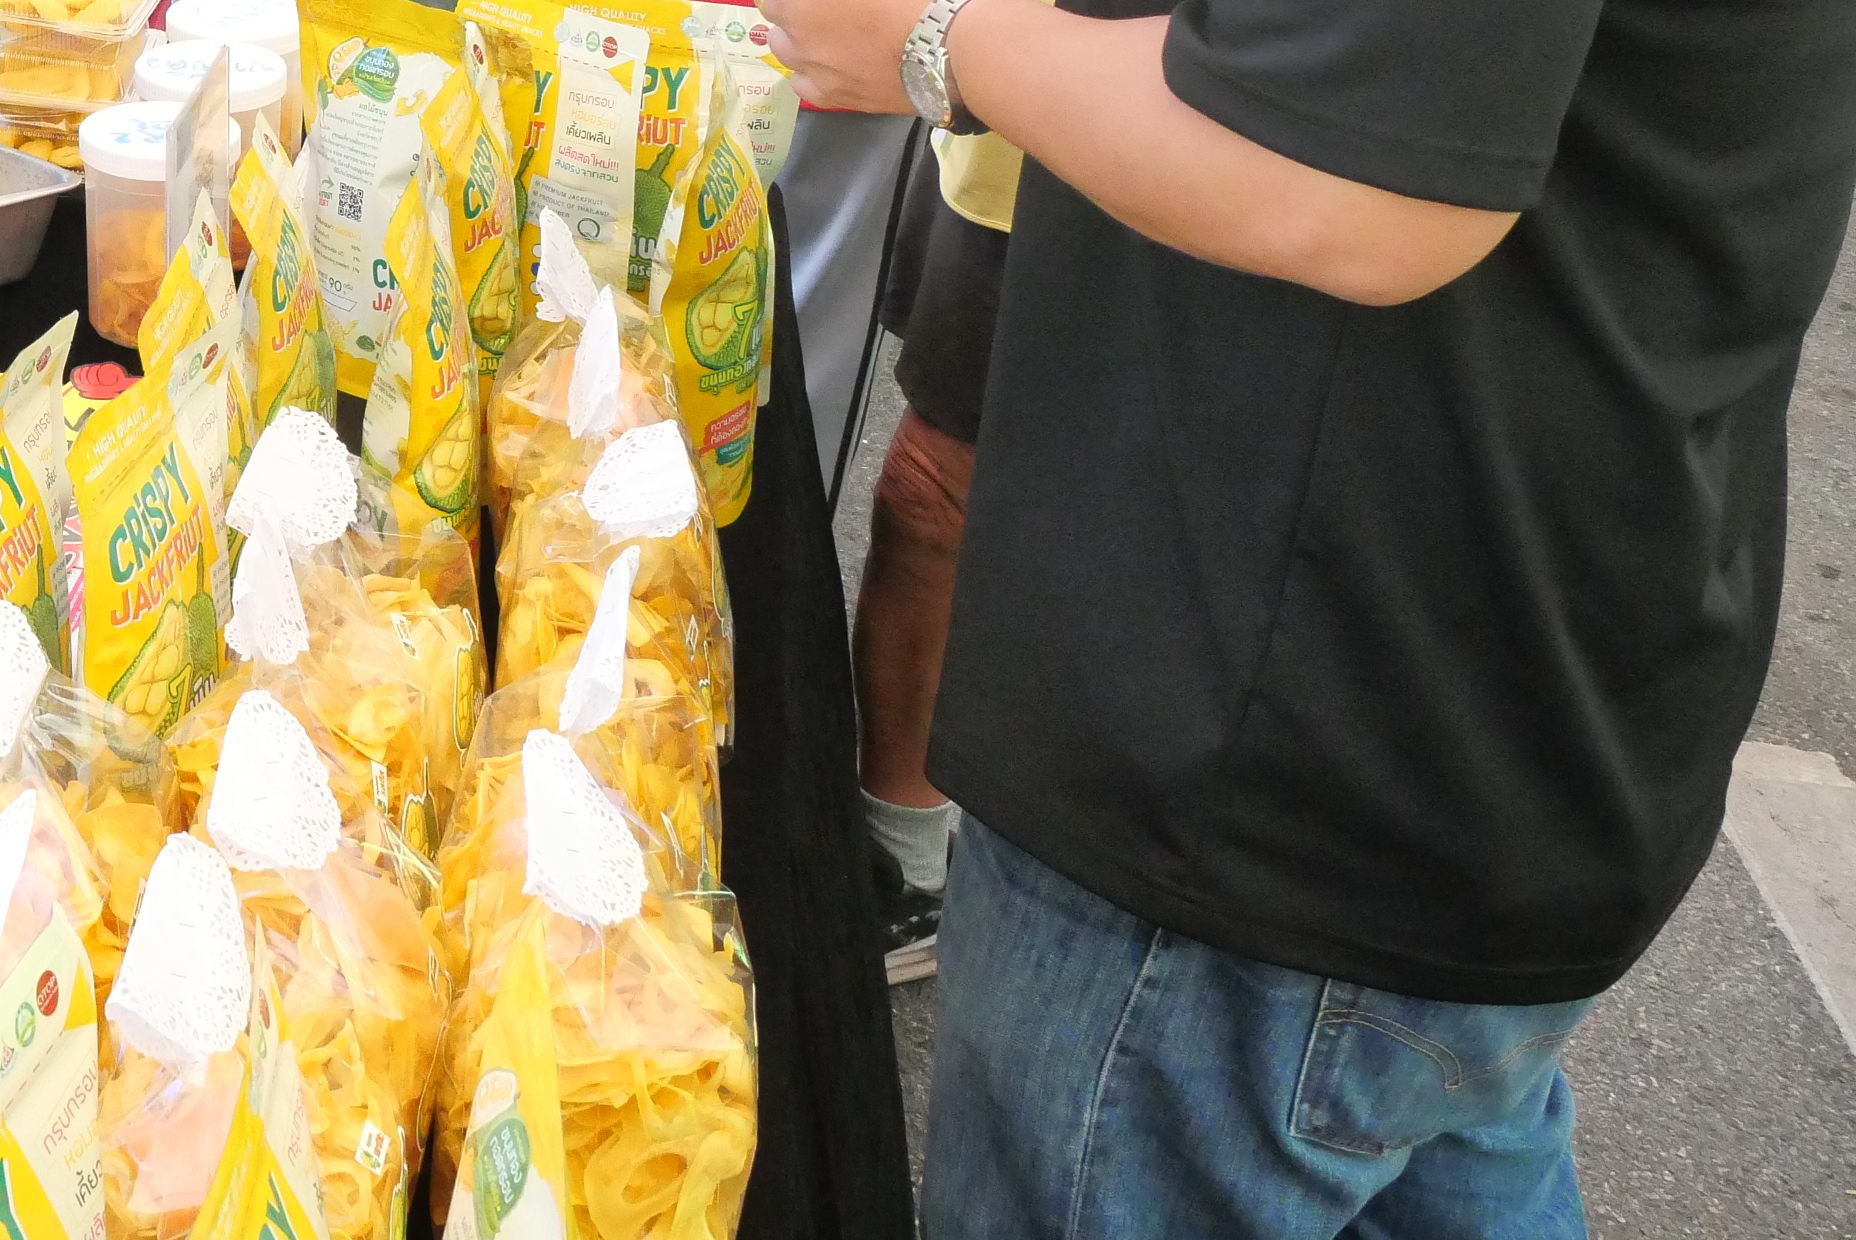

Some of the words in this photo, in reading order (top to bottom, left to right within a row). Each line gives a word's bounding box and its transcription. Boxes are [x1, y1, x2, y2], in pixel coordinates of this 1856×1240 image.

[479, 0, 499, 14] HIGH
[499, 5, 533, 23] QUALITY
[601, 8, 647, 23] QUALITY
[521, 24, 544, 38] SNACKS
[358, 63, 394, 78] ทอดกรอบ
[364, 54, 394, 70] ขนุนทอง
[569, 90, 615, 109] กรุบกรอบ
[565, 120, 612, 145] เคี้ยวเพลิน
[554, 158, 619, 183] ส่งตรงจากสวน
[698, 134, 746, 230] CRISPY
[539, 192, 565, 208] PRODUCT
[566, 202, 575, 211] OF
[577, 205, 611, 218] THAILAND
[541, 183, 567, 198] PREMIUM
[568, 193, 603, 206] JACKFRUIT
[328, 277, 342, 292] 90
[92, 430, 115, 458] HIGH
[116, 404, 147, 439] QUALITY
[109, 441, 191, 585] CRISPY
[110, 502, 205, 627] JACKFRIUT
[36, 974, 56, 1007] OTOP
